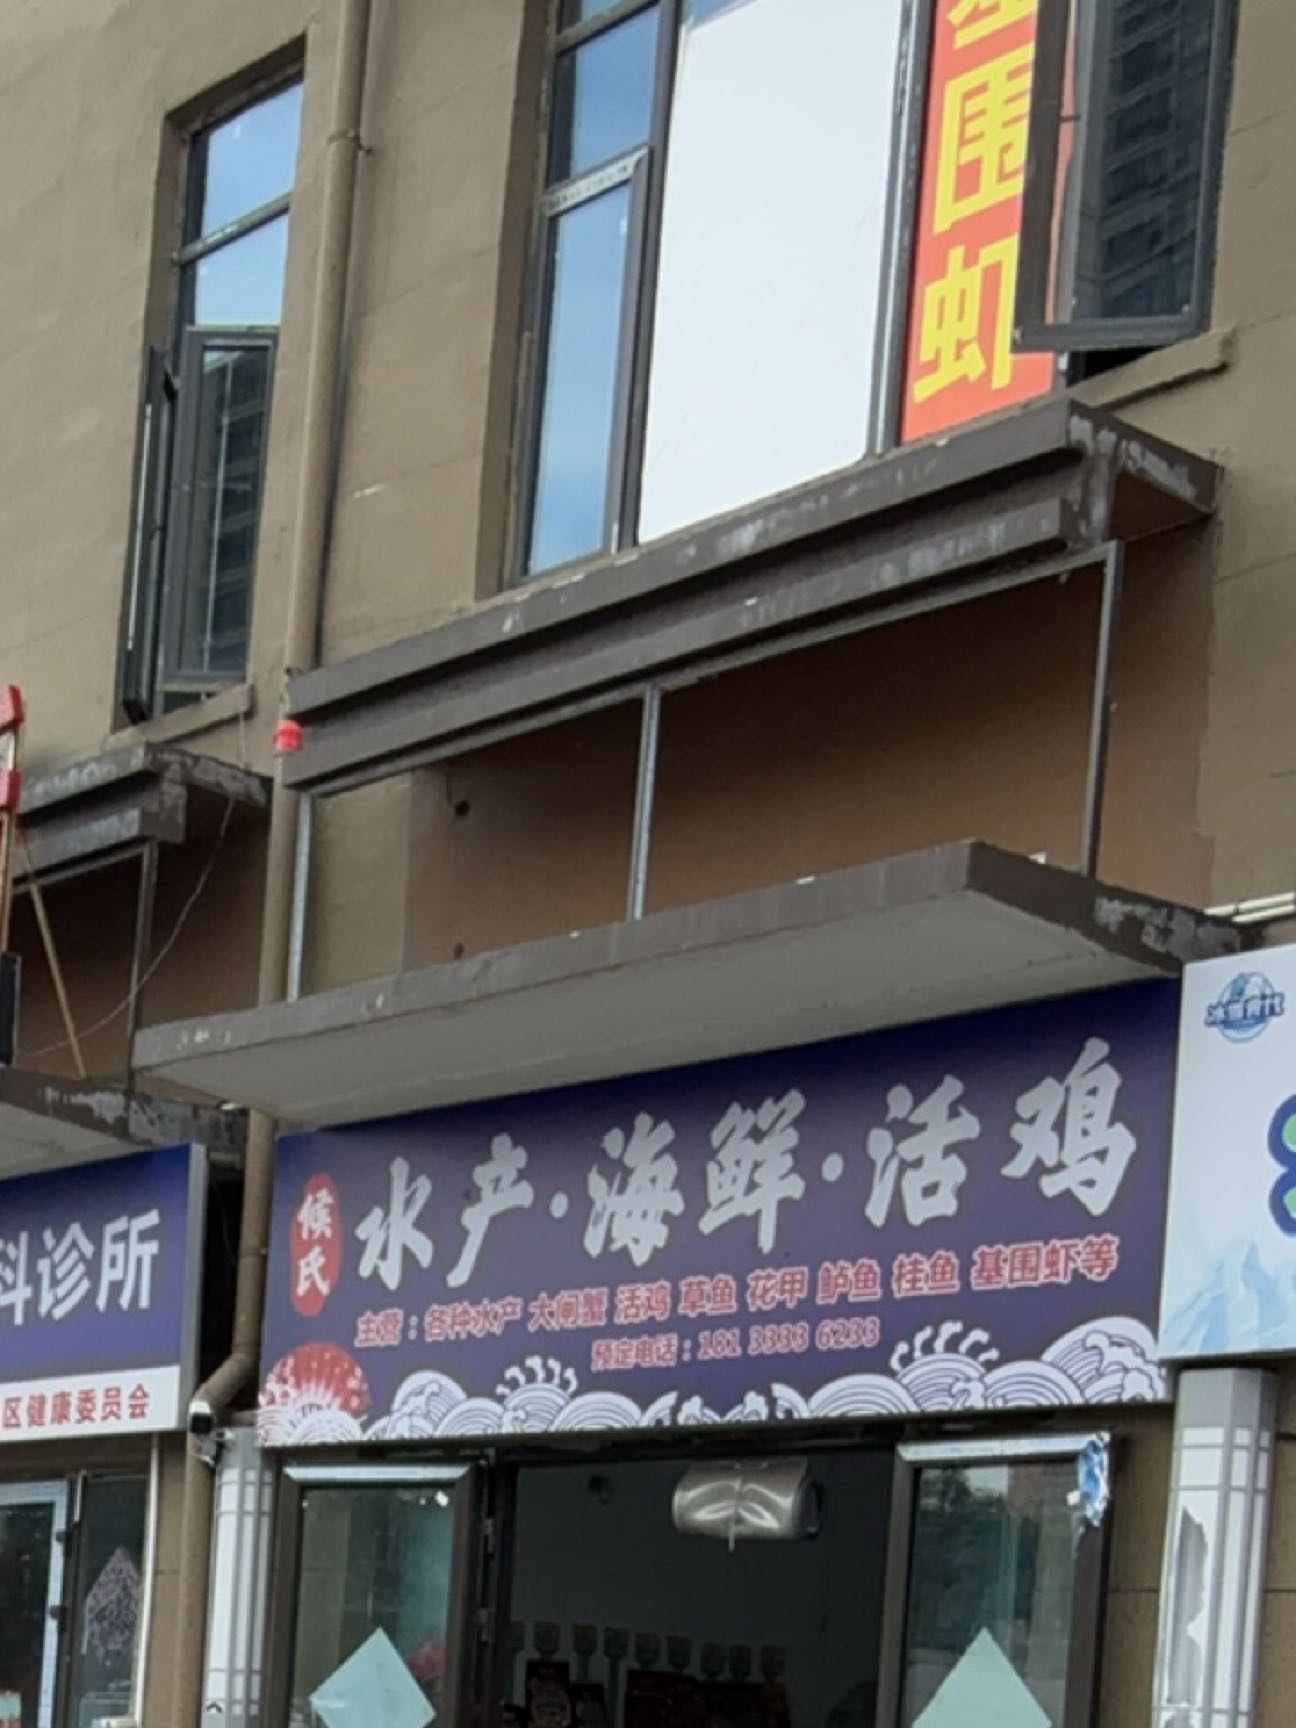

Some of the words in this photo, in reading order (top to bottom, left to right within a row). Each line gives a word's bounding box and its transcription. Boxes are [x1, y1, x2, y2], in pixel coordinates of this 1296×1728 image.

[746, 1266, 809, 1312] 花甲
[970, 1232, 1119, 1291] 基围虾等
